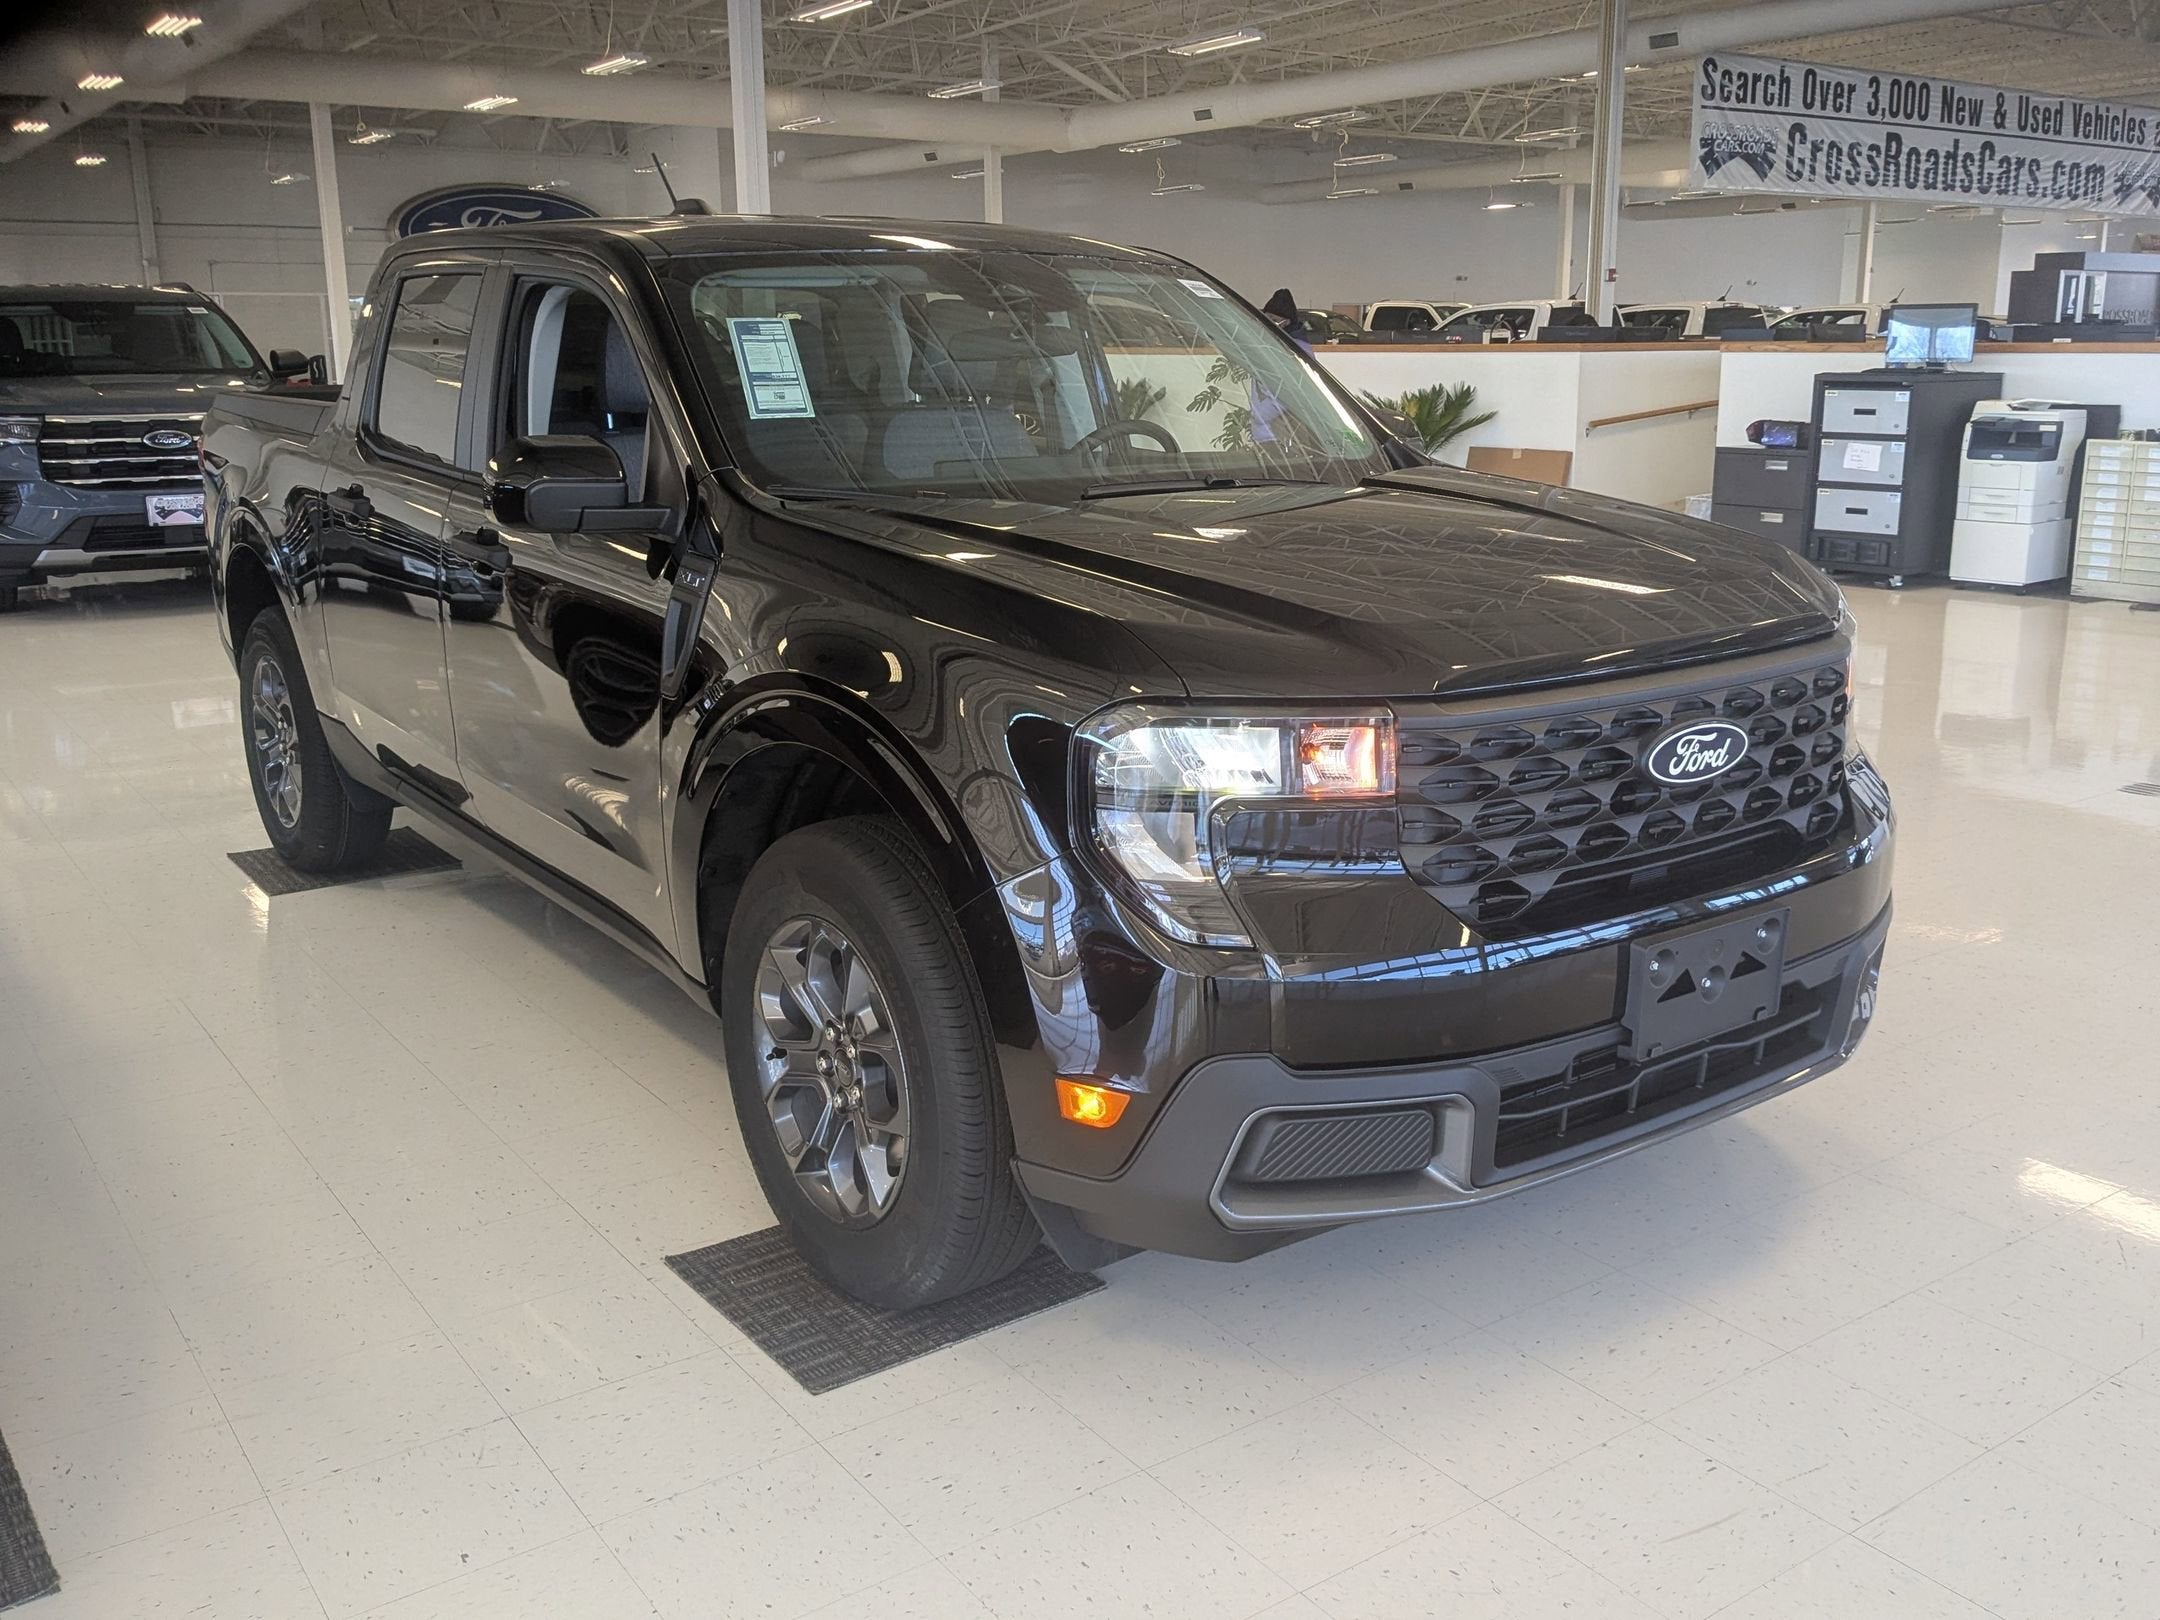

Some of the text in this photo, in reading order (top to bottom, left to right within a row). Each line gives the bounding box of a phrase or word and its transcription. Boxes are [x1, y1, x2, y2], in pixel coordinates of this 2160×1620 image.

[1701, 57, 1791, 108] Search
[1802, 68, 1857, 113] Over
[1867, 75, 1931, 121] 3,000
[1940, 85, 1984, 127] New
[1993, 91, 2008, 129] &
[2018, 95, 2064, 136] Used
[2072, 101, 2147, 146] Vehicles
[1714, 139, 1766, 155] CARS.COM
[1785, 121, 2105, 202] CrossRoadsCars.com
[680, 568, 706, 588] XLT
[1669, 732, 1732, 776] Ford
